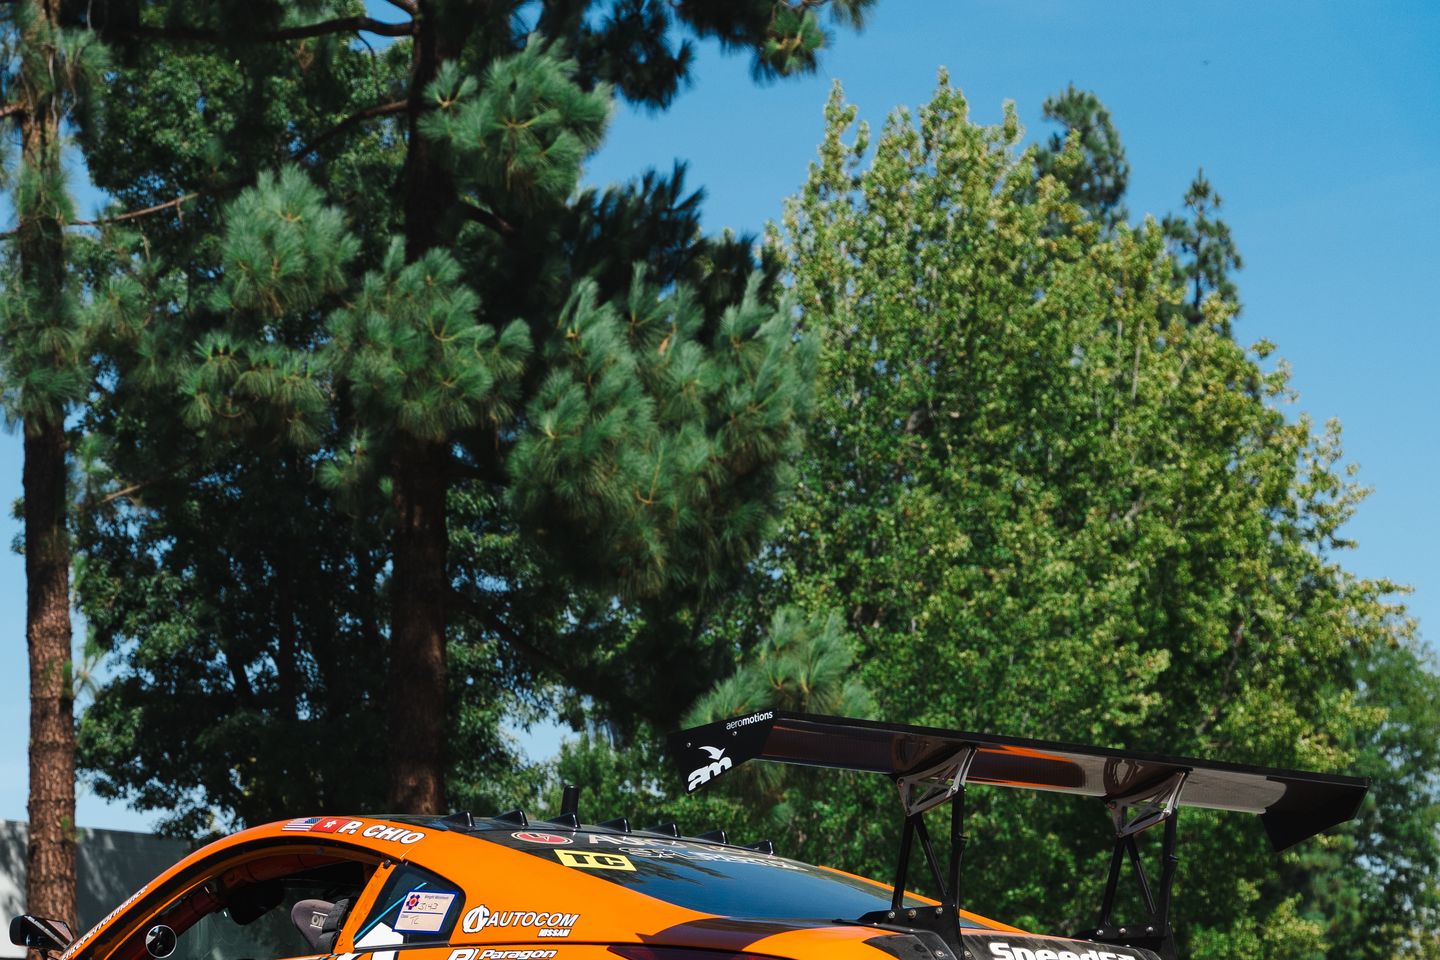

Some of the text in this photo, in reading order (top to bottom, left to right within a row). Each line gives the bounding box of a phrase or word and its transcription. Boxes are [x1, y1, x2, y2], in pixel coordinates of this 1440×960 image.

[726, 711, 774, 730] aeromotions
[337, 820, 426, 845] P. CHIO
[563, 852, 625, 867] TC
[486, 911, 580, 927] AUTOCOM
[538, 928, 572, 937] NISSAN
[478, 949, 558, 960] Paragon
